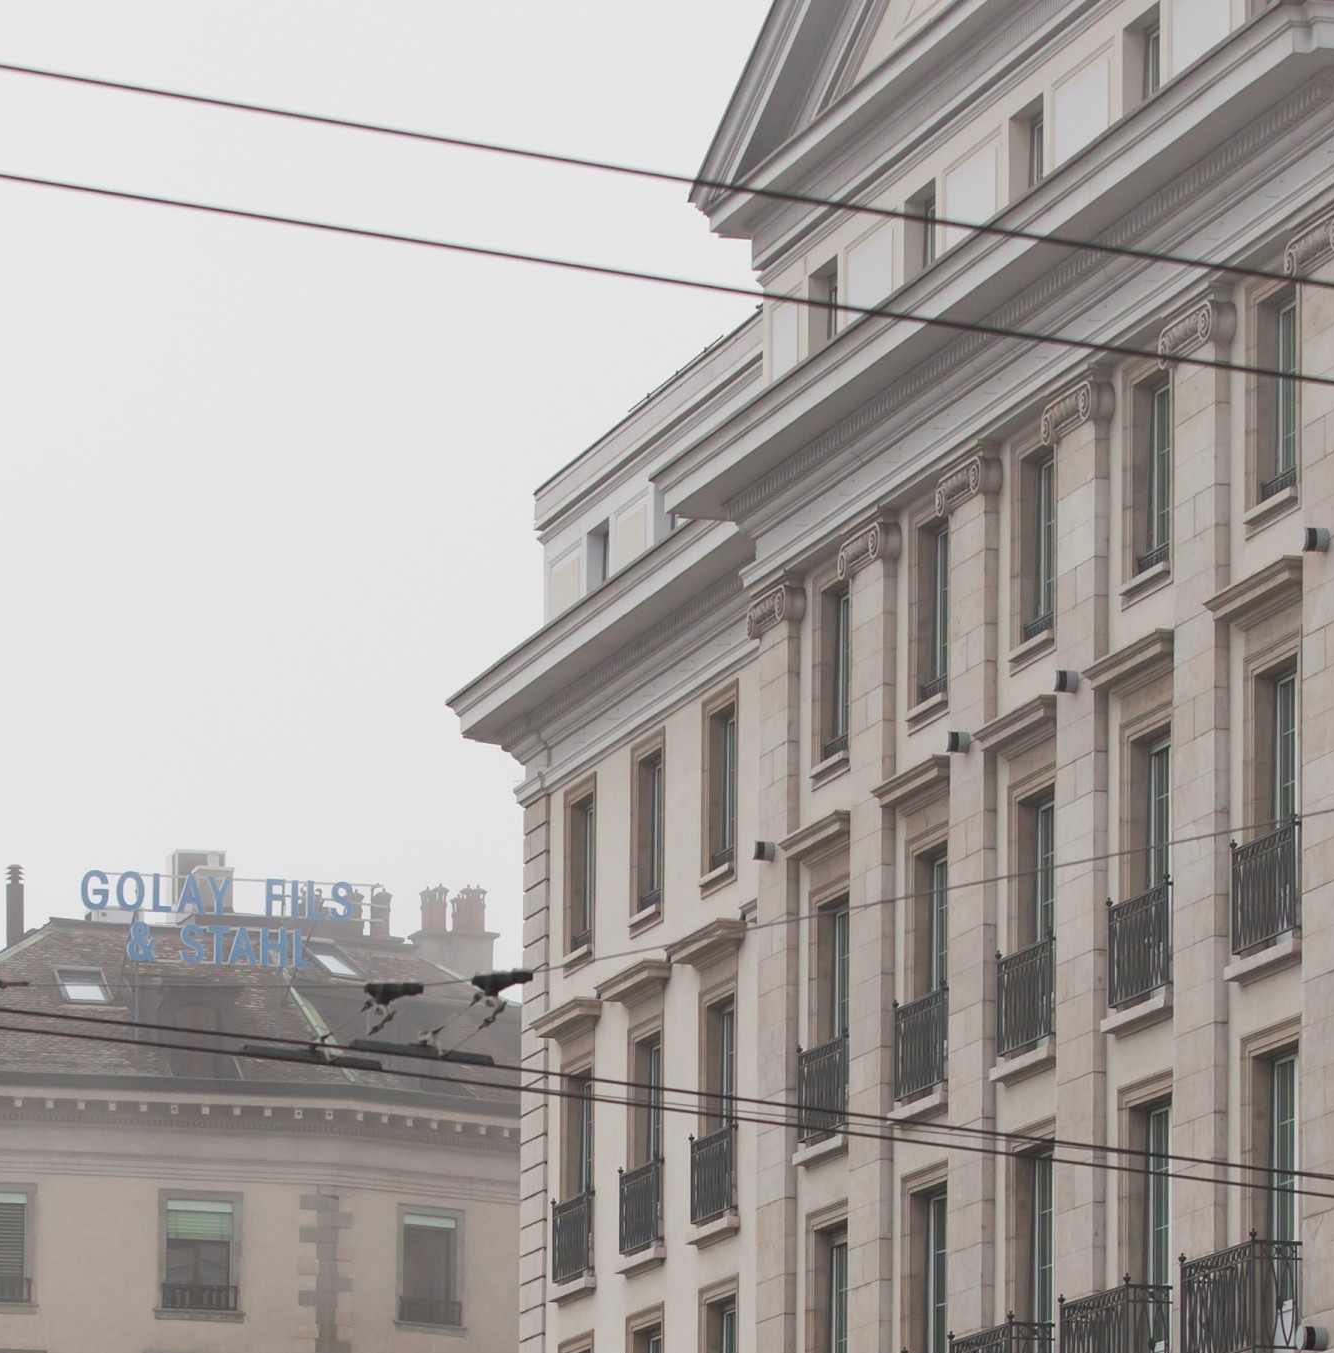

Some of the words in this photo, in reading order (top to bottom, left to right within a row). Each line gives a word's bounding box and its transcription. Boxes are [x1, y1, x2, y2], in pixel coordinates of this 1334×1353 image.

[80, 869, 232, 915] GOLAY
[266, 878, 354, 922] FILS
[126, 921, 157, 962] &
[179, 924, 315, 968] STAHL
